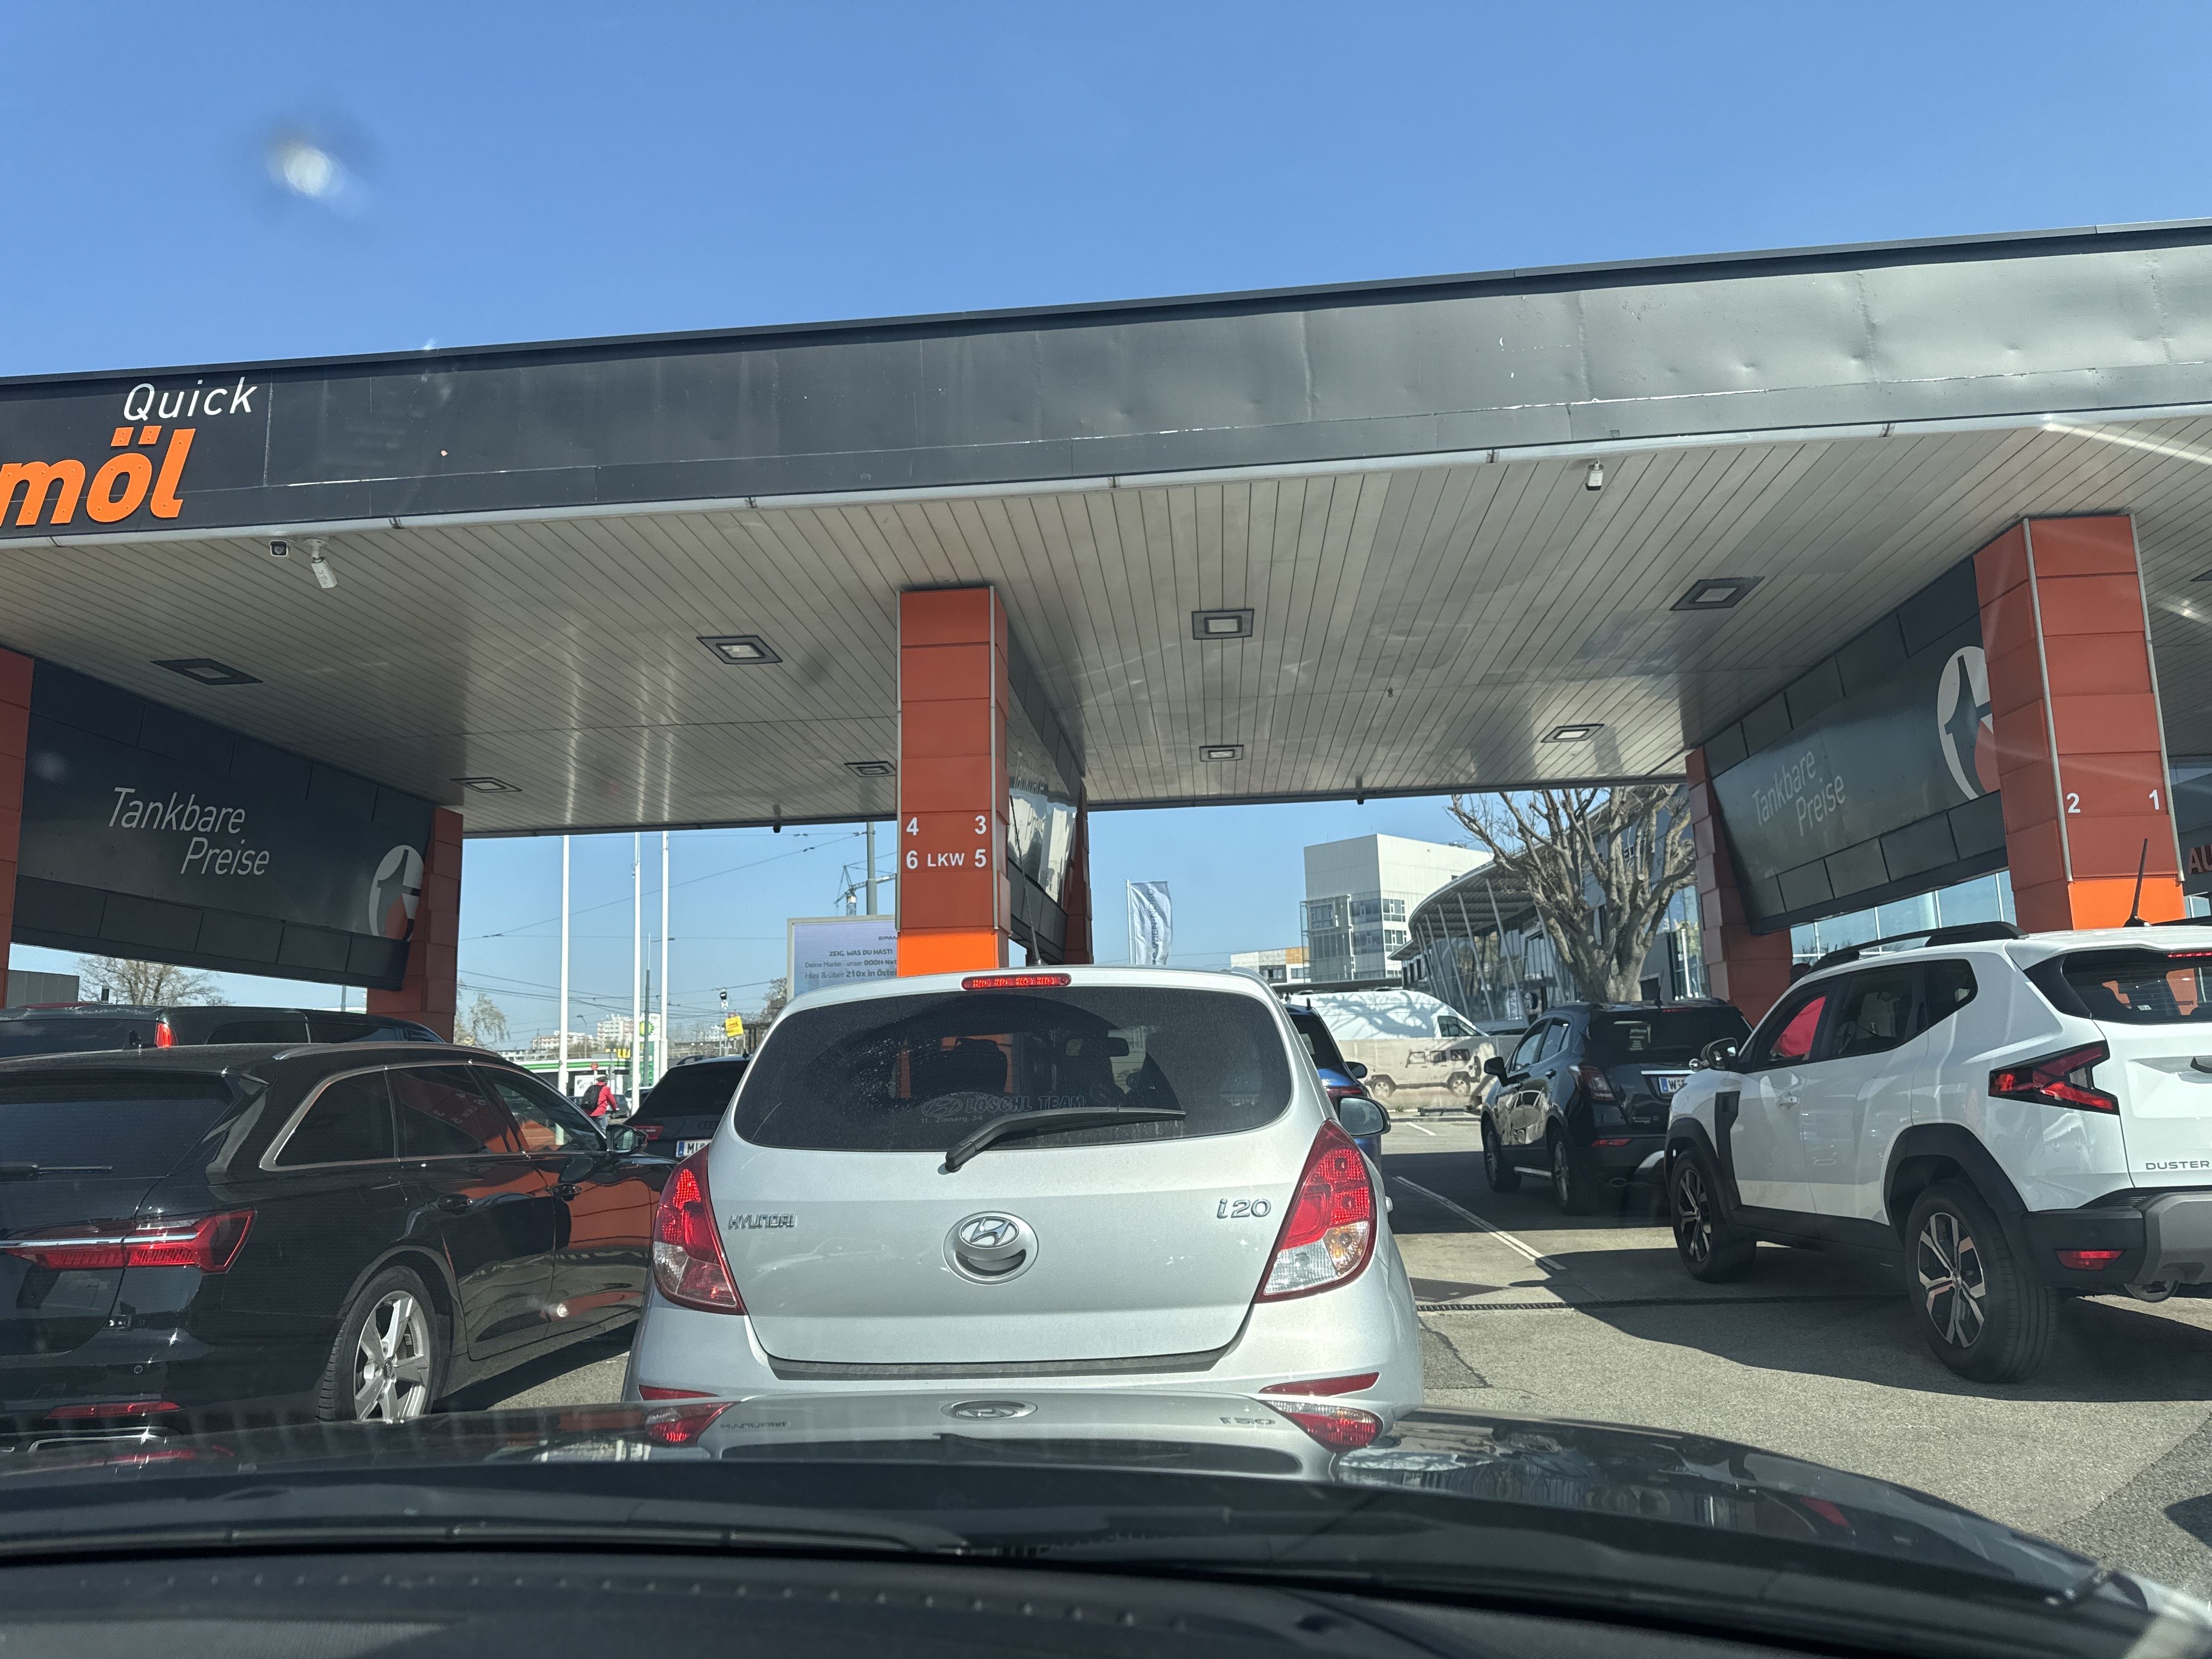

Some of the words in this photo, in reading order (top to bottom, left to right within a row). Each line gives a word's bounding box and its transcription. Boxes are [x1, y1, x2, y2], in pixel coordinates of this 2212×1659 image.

[123, 377, 258, 421] Quick
[0, 425, 196, 526] möl
[1752, 750, 1817, 826] Tankbare
[2067, 792, 2081, 813] 2
[2148, 789, 2159, 810] 1
[109, 787, 246, 834] Tankbare
[1796, 775, 1845, 837] Preise
[906, 817, 919, 836] 4
[974, 815, 987, 834] 3
[180, 837, 270, 875] Preise
[906, 850, 919, 869] 6
[927, 853, 965, 867] LKW
[974, 849, 987, 868] 5
[1146, 888, 1157, 918] NORD
[965, 1094, 1032, 1113] LÖSCHL
[1038, 1095, 1085, 1108] TEAM
[2145, 1160, 2210, 1170] DUSTER
[728, 1213, 797, 1230] HYUNDAI
[1217, 1198, 1271, 1219] i20
